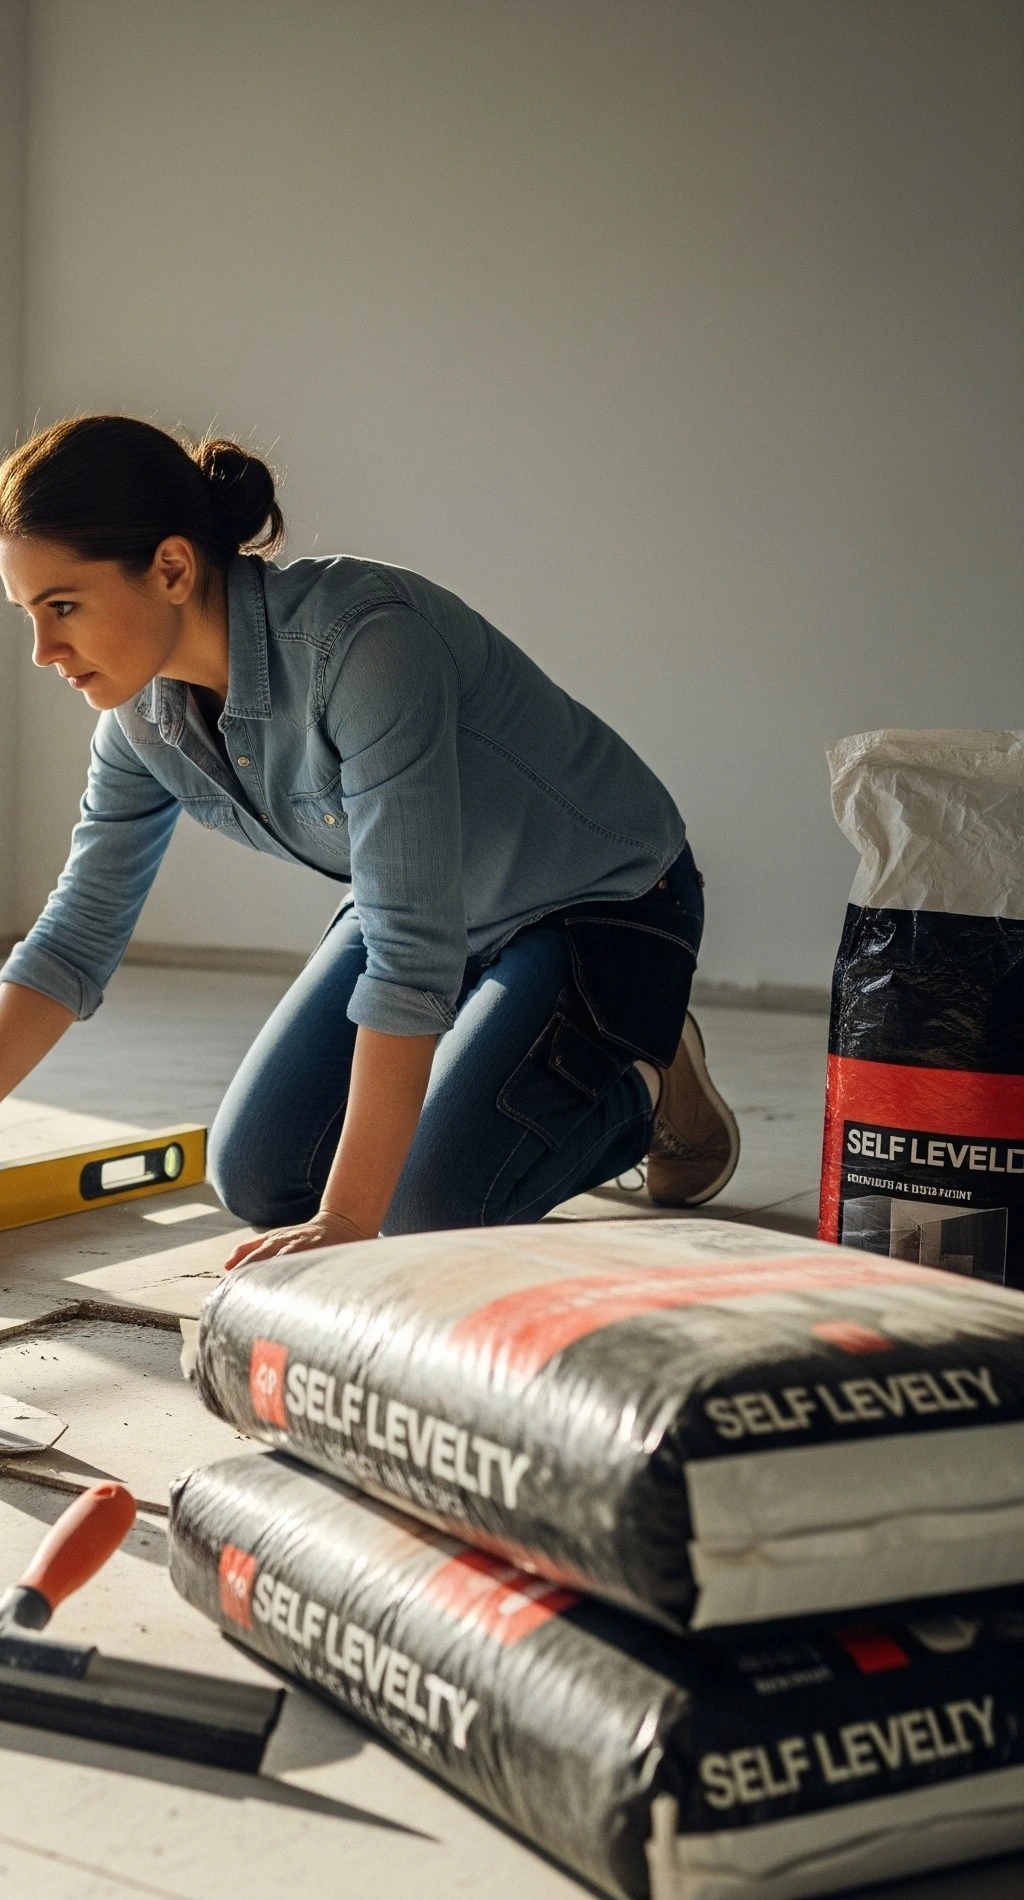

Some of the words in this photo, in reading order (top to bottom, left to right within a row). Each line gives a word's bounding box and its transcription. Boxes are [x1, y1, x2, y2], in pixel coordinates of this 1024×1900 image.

[847, 1128, 906, 1161] SELF
[286, 1362, 365, 1436] SELF
[366, 1392, 530, 1509] LEVELTY
[705, 1386, 817, 1439] SELF
[252, 1573, 325, 1650] SELF
[326, 1615, 479, 1750] LEVELTY
[699, 1735, 811, 1811] SELF
